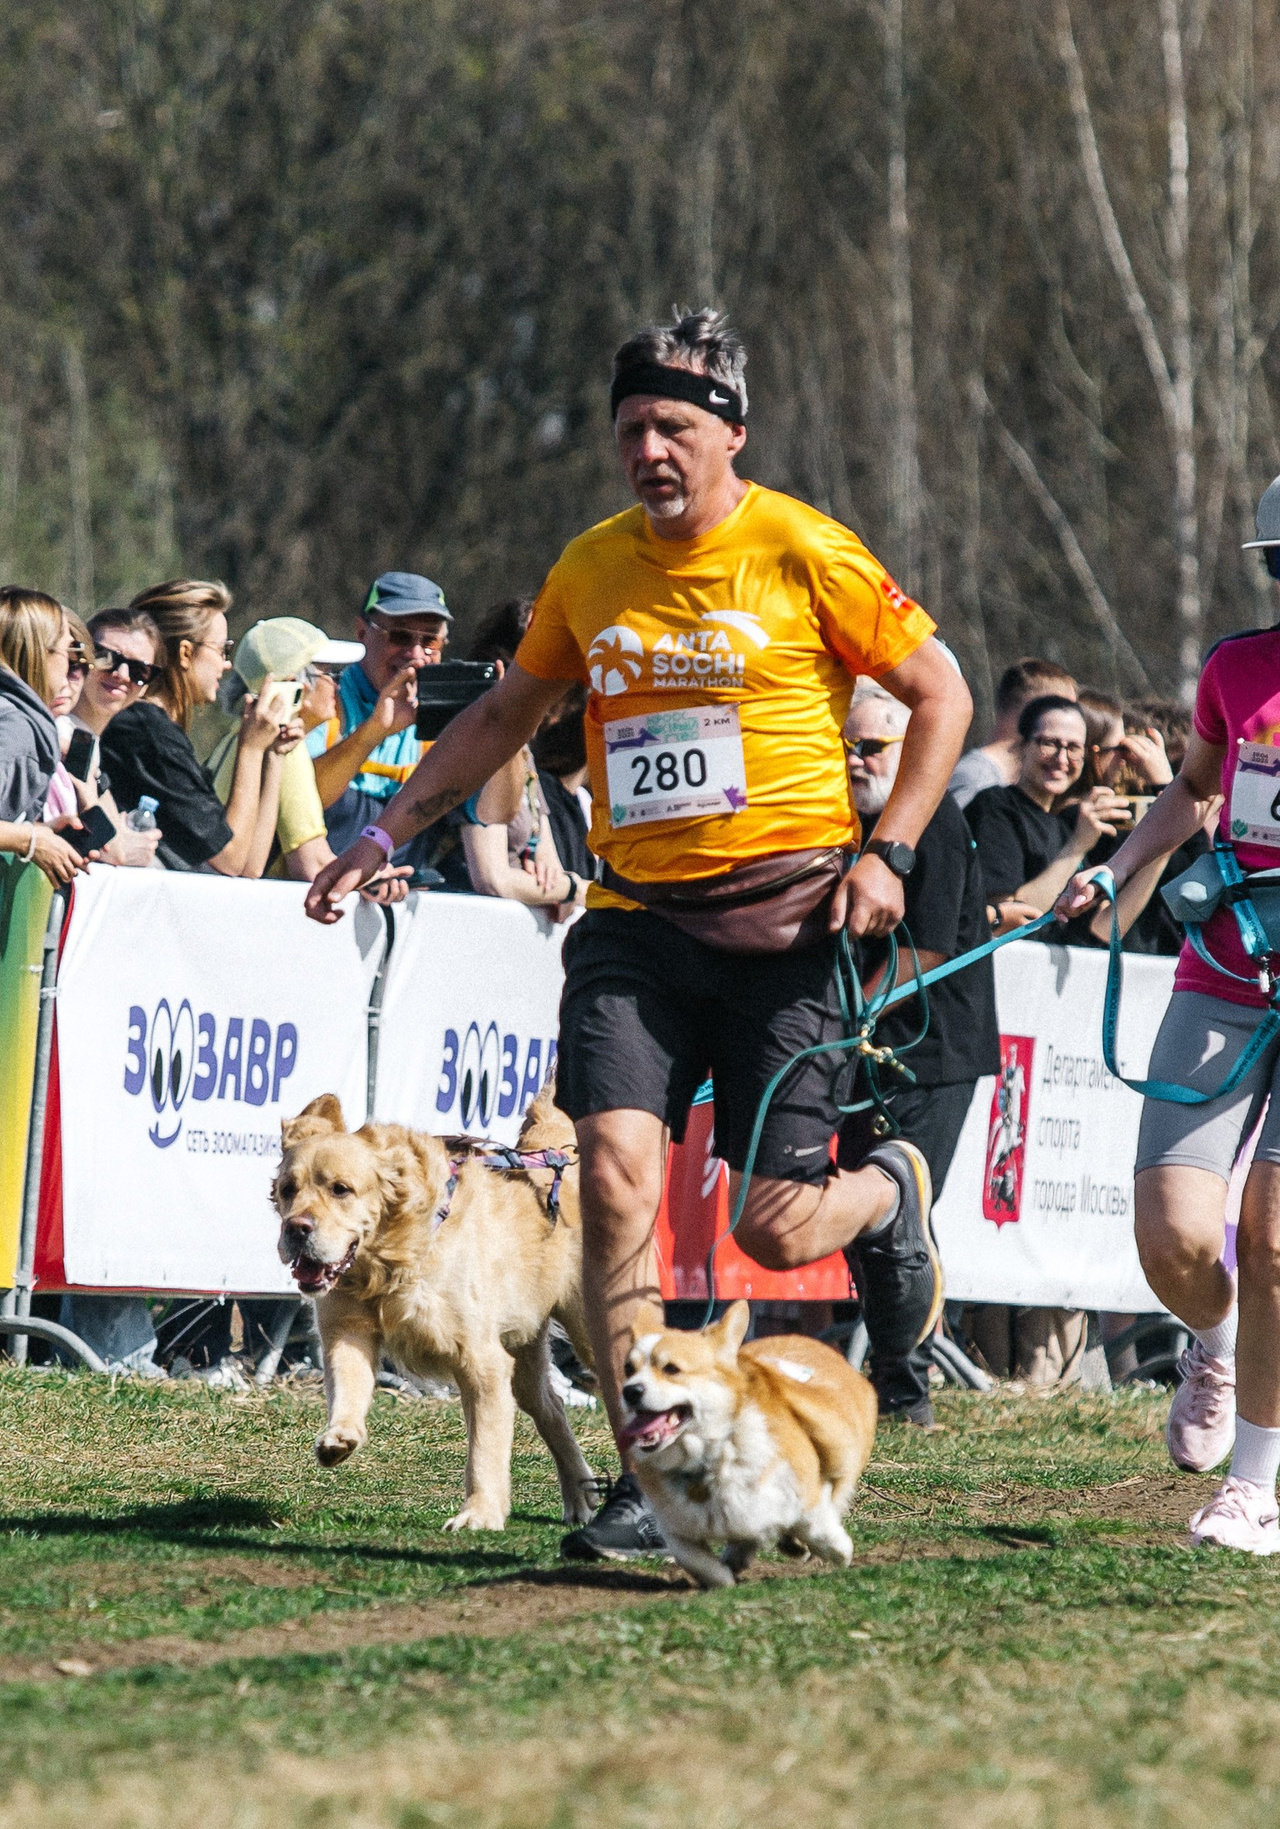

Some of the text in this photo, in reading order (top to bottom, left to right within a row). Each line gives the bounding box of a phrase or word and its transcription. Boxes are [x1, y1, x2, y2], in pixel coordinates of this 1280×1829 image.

[652, 629, 732, 652] ANTA
[652, 653, 745, 675] SOCHI
[653, 677, 744, 688] MARATHON
[704, 718, 712, 727] 2
[631, 748, 707, 796] 280
[435, 1020, 558, 1130] ЗООЗА
[186, 1130, 283, 1157] СЕТЬ ЗООМАГАЗИН
[1038, 1114, 1081, 1160] спорта
[1033, 1178, 1077, 1222] города
